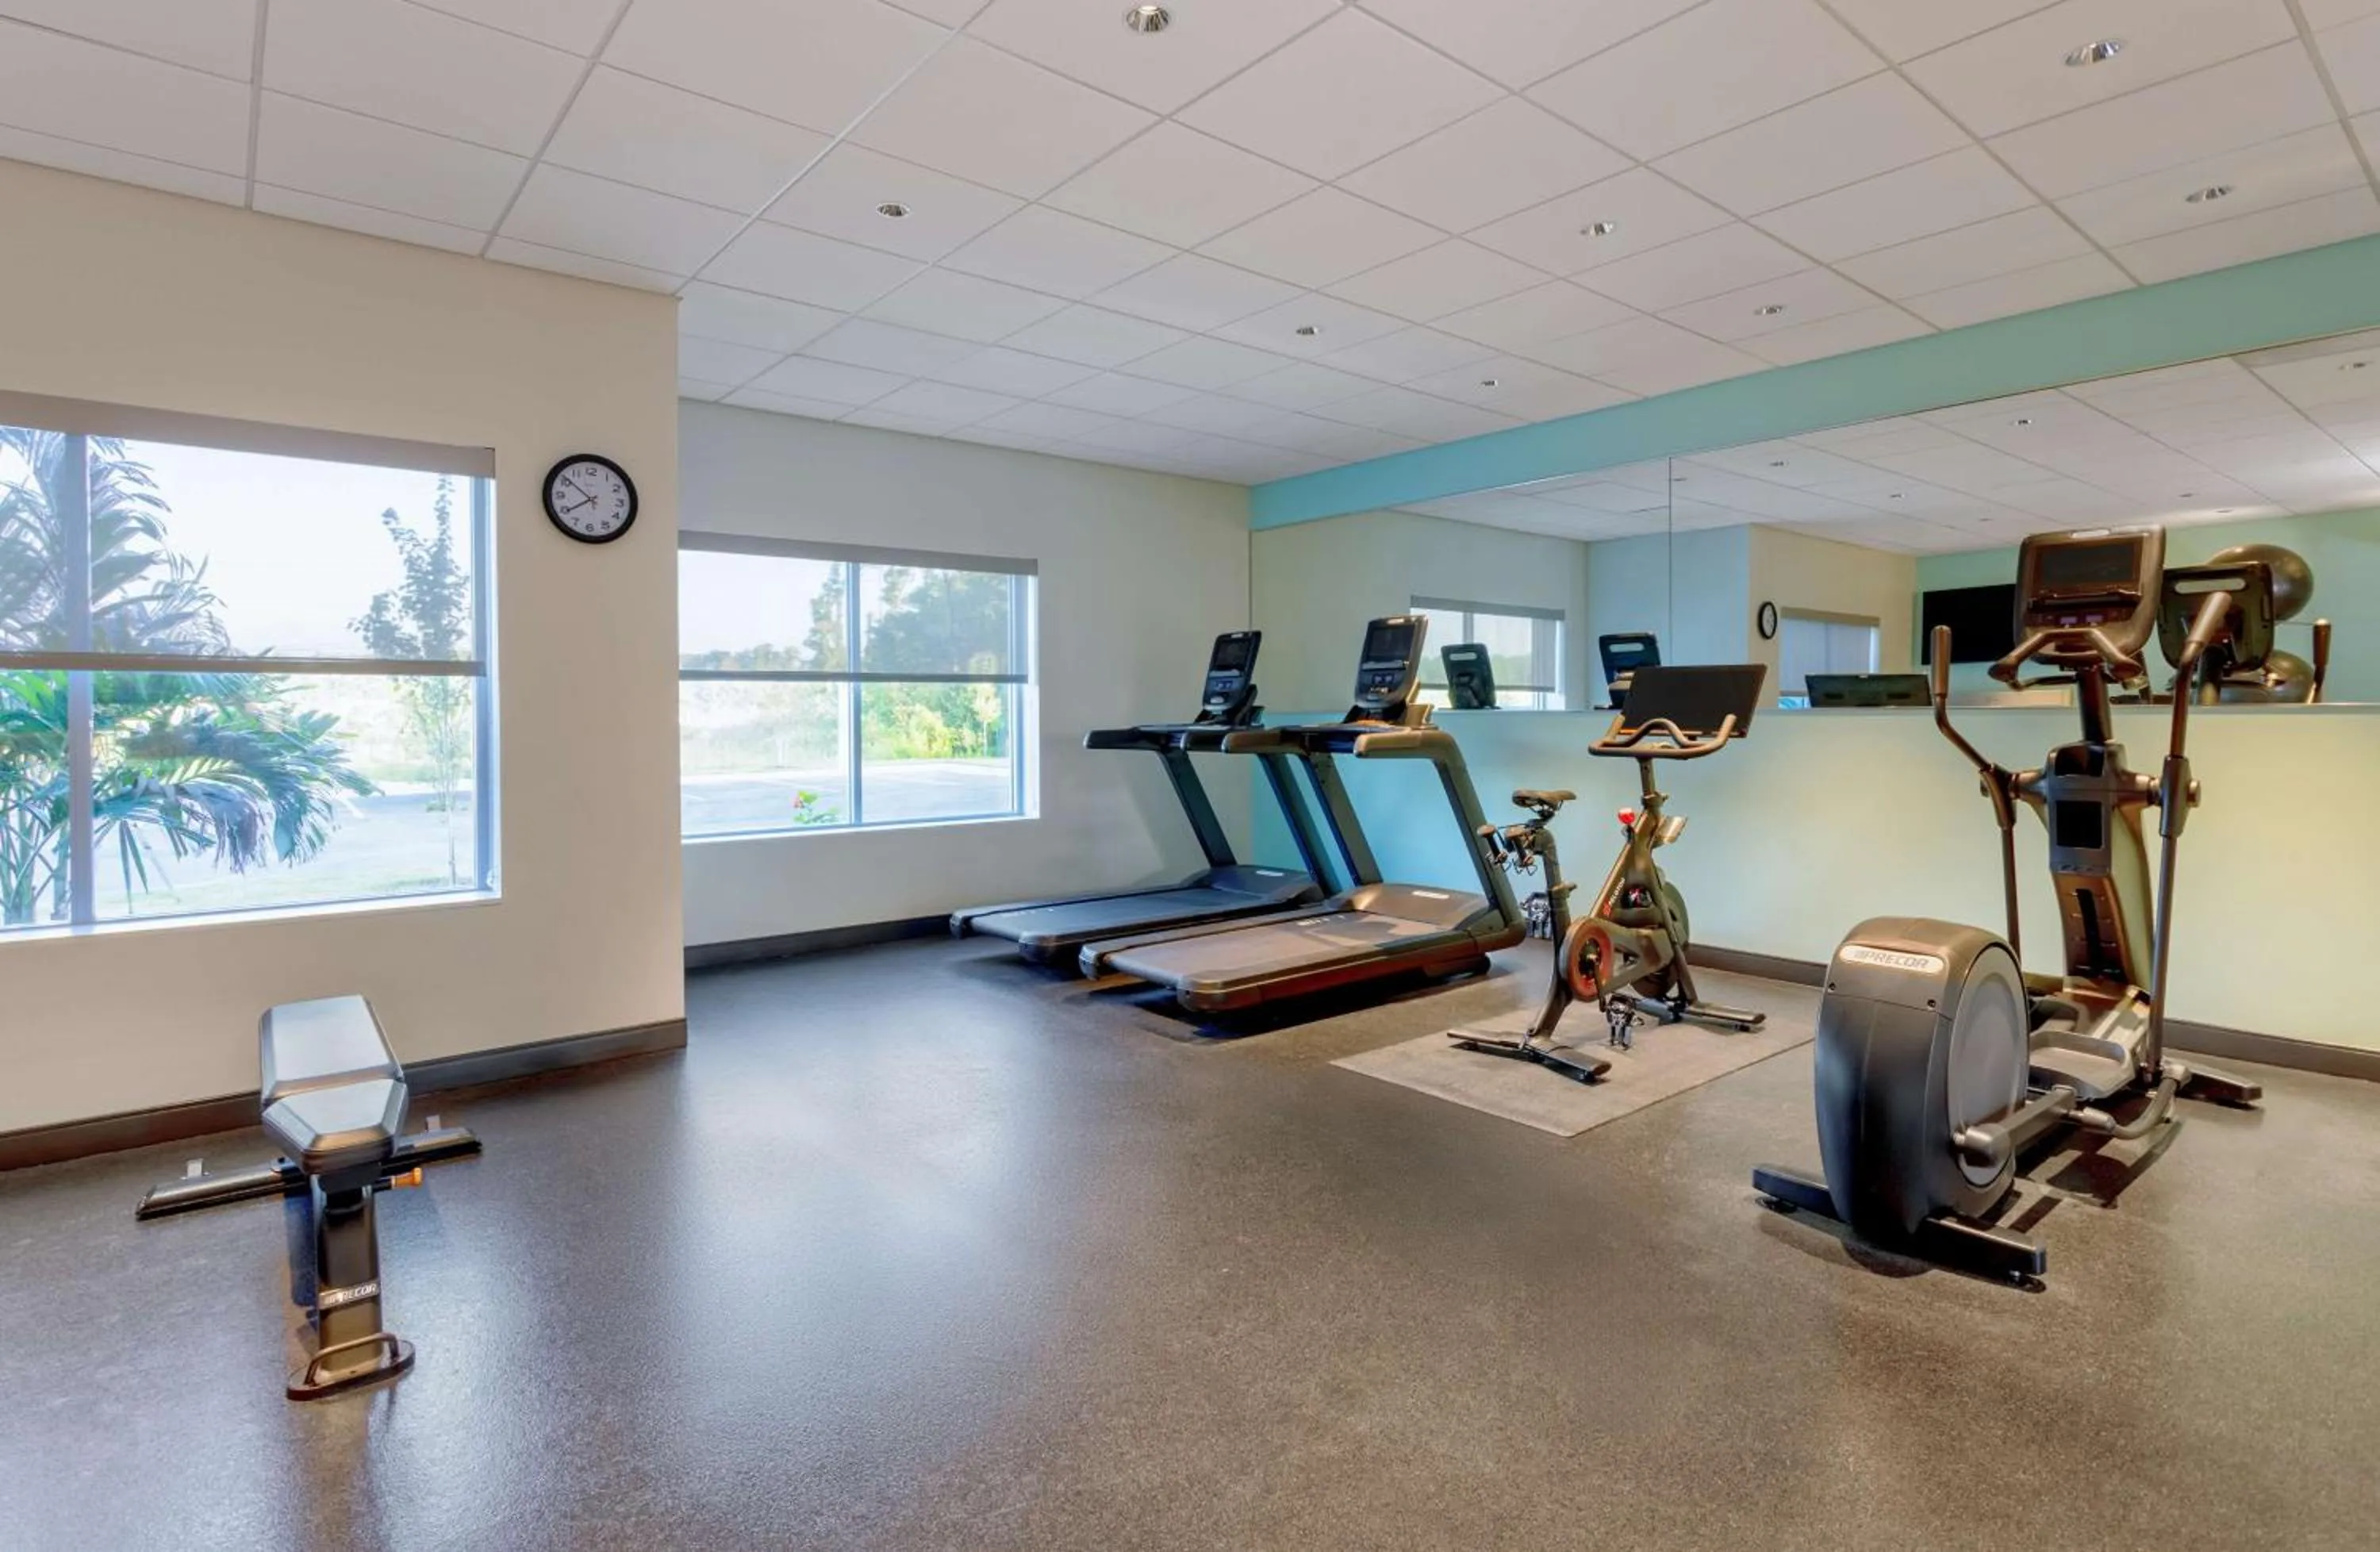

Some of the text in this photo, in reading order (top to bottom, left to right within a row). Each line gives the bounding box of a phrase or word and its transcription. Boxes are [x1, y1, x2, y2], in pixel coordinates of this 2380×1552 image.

[572, 469, 581, 478] 11
[585, 467, 597, 477] 12
[612, 483, 622, 493] 2
[556, 491, 566, 500] 9
[615, 498, 624, 508] 3
[571, 517, 581, 526] 7
[601, 520, 610, 529] 5
[585, 524, 594, 532] 6
[1864, 951, 1929, 969] PRECOR
